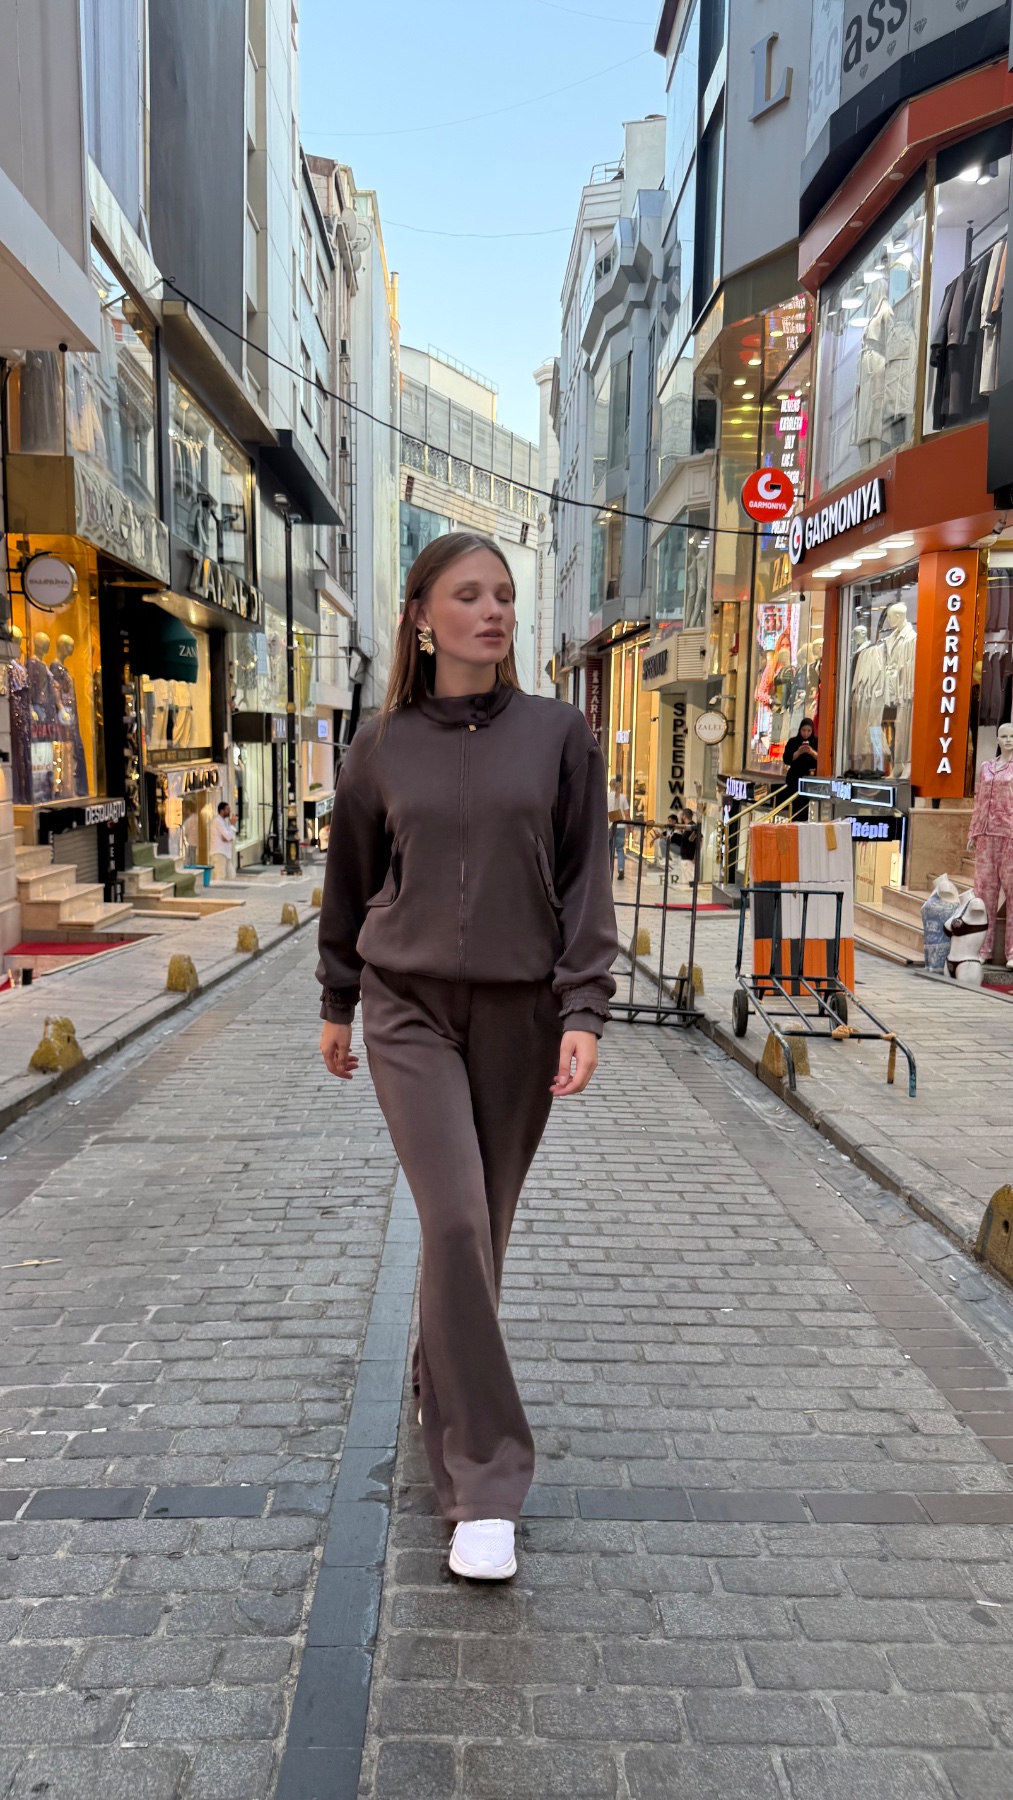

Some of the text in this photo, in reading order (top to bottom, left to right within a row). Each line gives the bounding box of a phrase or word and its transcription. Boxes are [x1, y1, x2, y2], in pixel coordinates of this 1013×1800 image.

[749, 501, 787, 510] GARMONIYA
[805, 478, 882, 550] GARMONIYA
[937, 594, 961, 774] GARMONIYA
[668, 703, 685, 810] SPEEDWA
[852, 822, 889, 839] Répit
